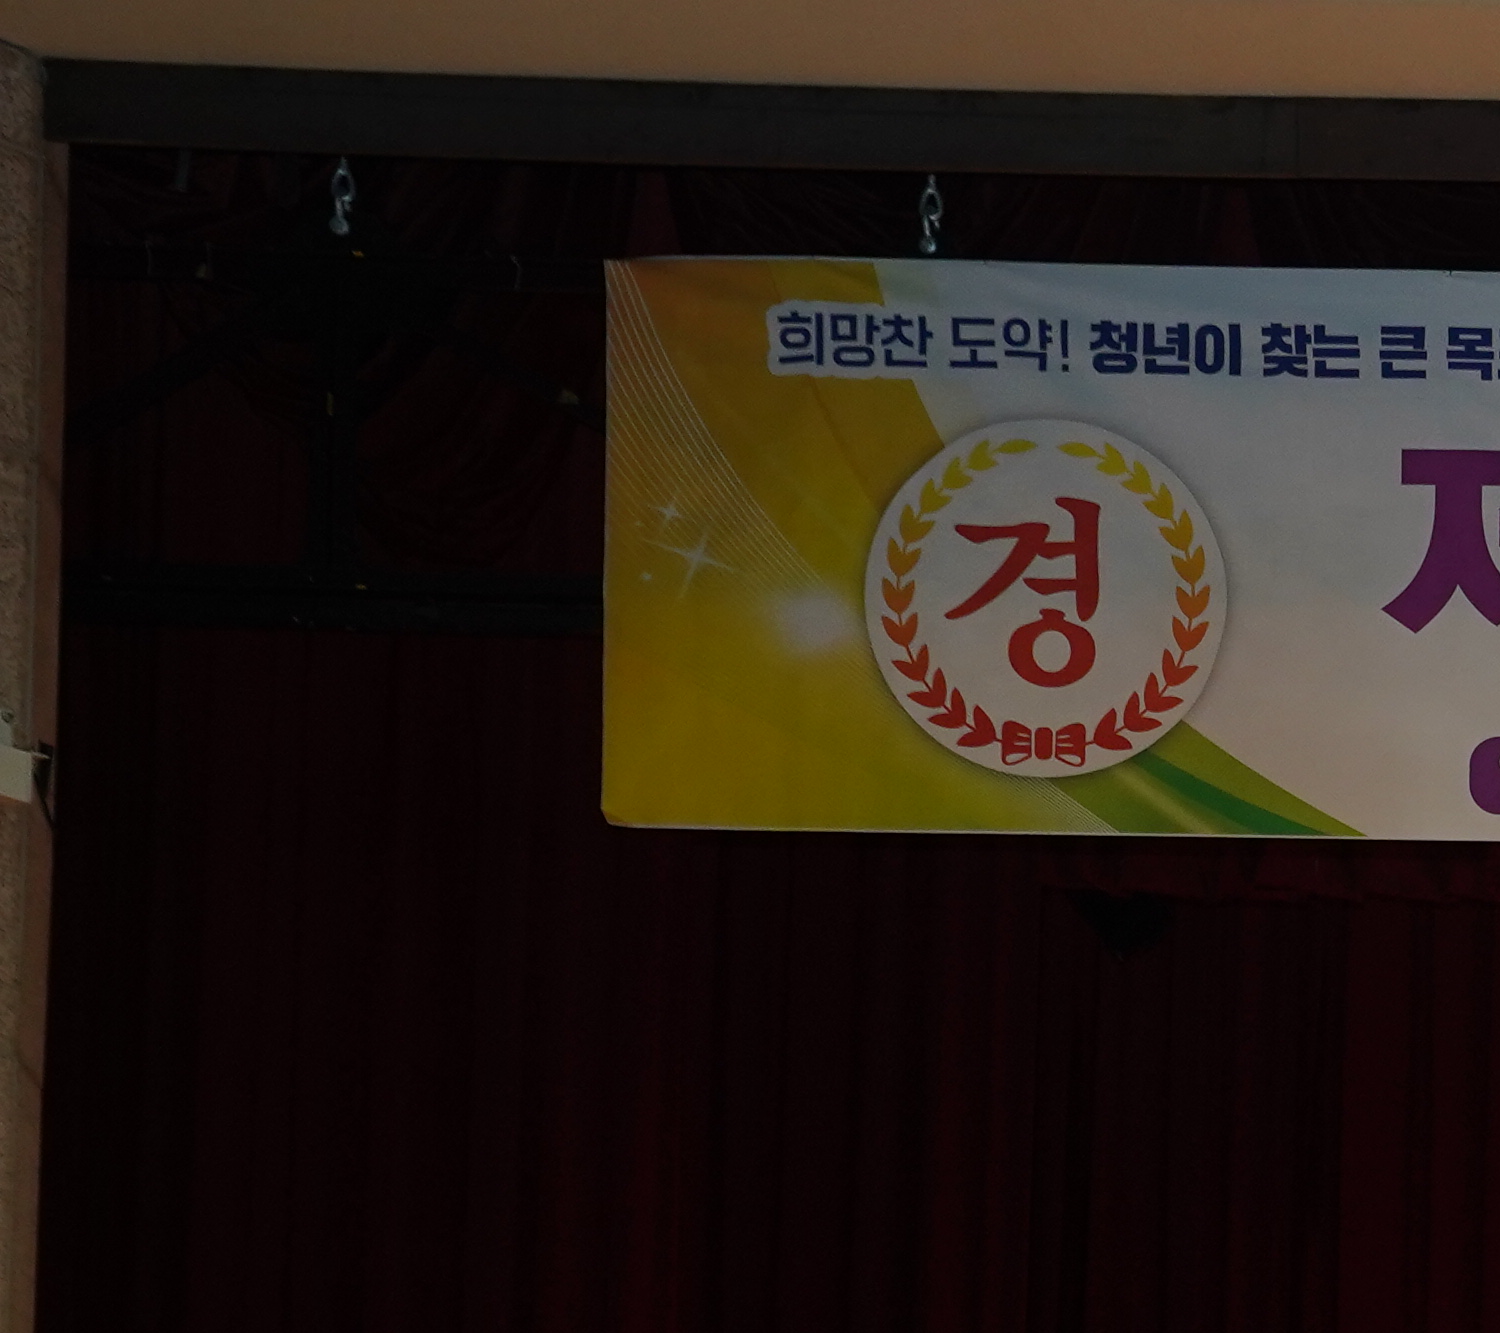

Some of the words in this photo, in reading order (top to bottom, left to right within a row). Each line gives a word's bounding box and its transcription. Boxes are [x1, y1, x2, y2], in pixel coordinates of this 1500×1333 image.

[777, 310, 933, 367] 희망찬
[950, 318, 1069, 372] 도약!
[1090, 320, 1241, 376] 청년이
[1262, 323, 1360, 378] 찾는
[1379, 326, 1427, 379] 큰
[945, 497, 1102, 688] 경
